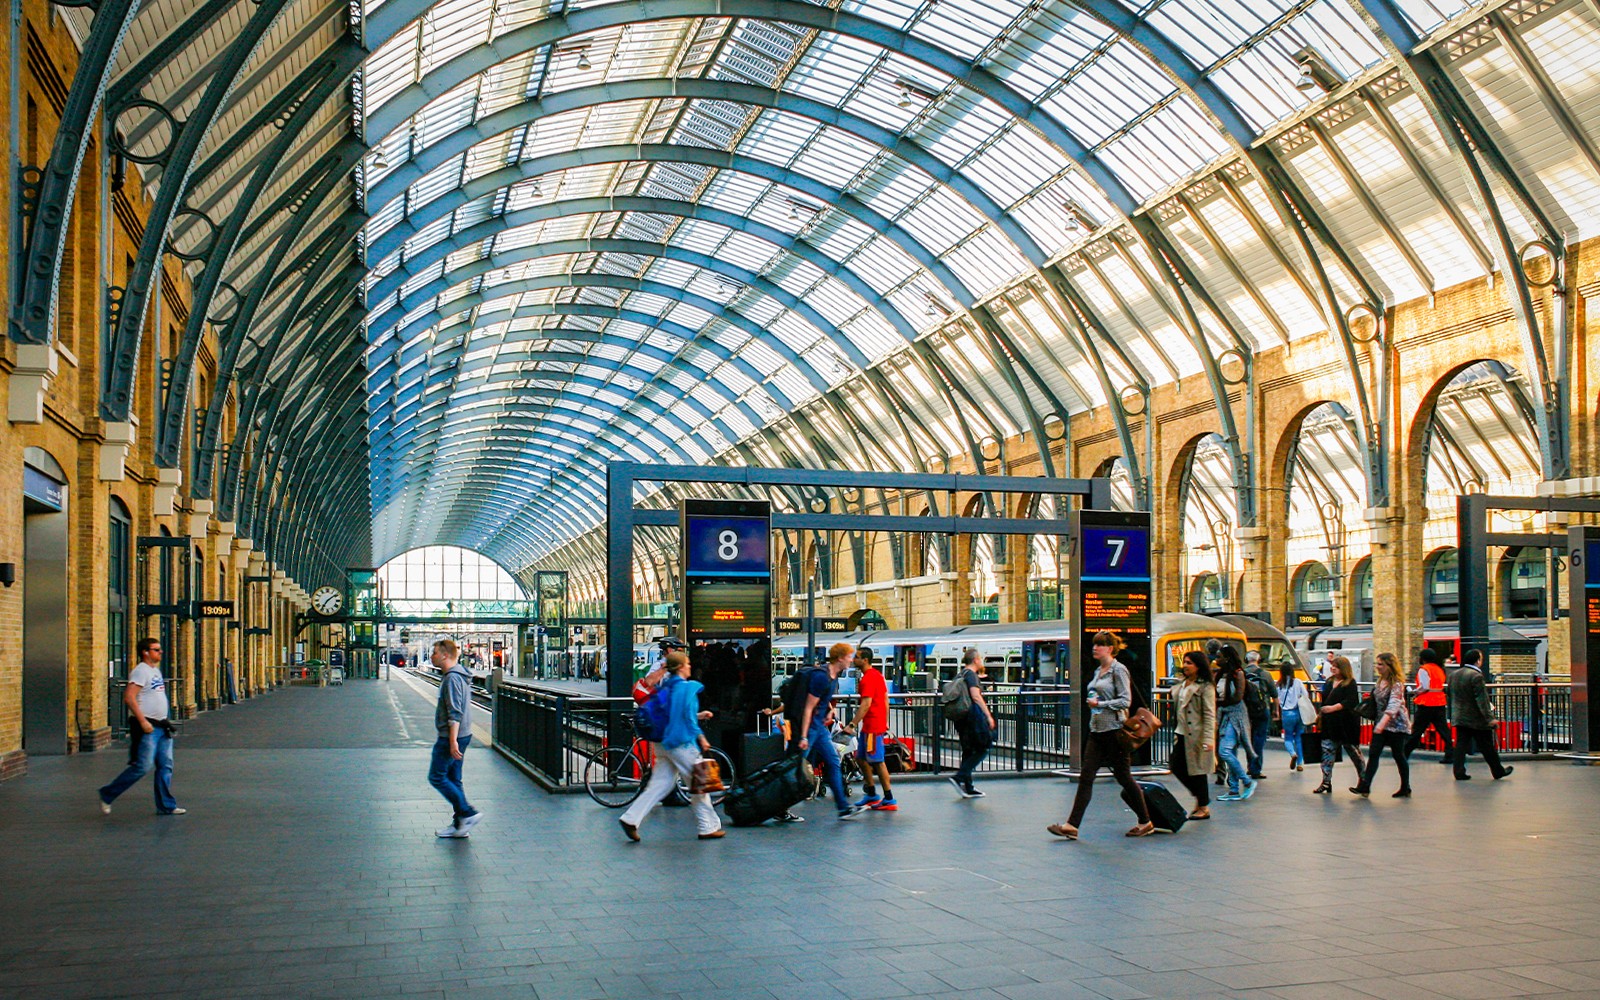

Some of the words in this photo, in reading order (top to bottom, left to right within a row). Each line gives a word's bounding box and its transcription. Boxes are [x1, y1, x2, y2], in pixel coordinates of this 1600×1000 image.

[718, 529, 738, 560] 8
[1107, 539, 1125, 567] 7
[1571, 548, 1582, 567] 6
